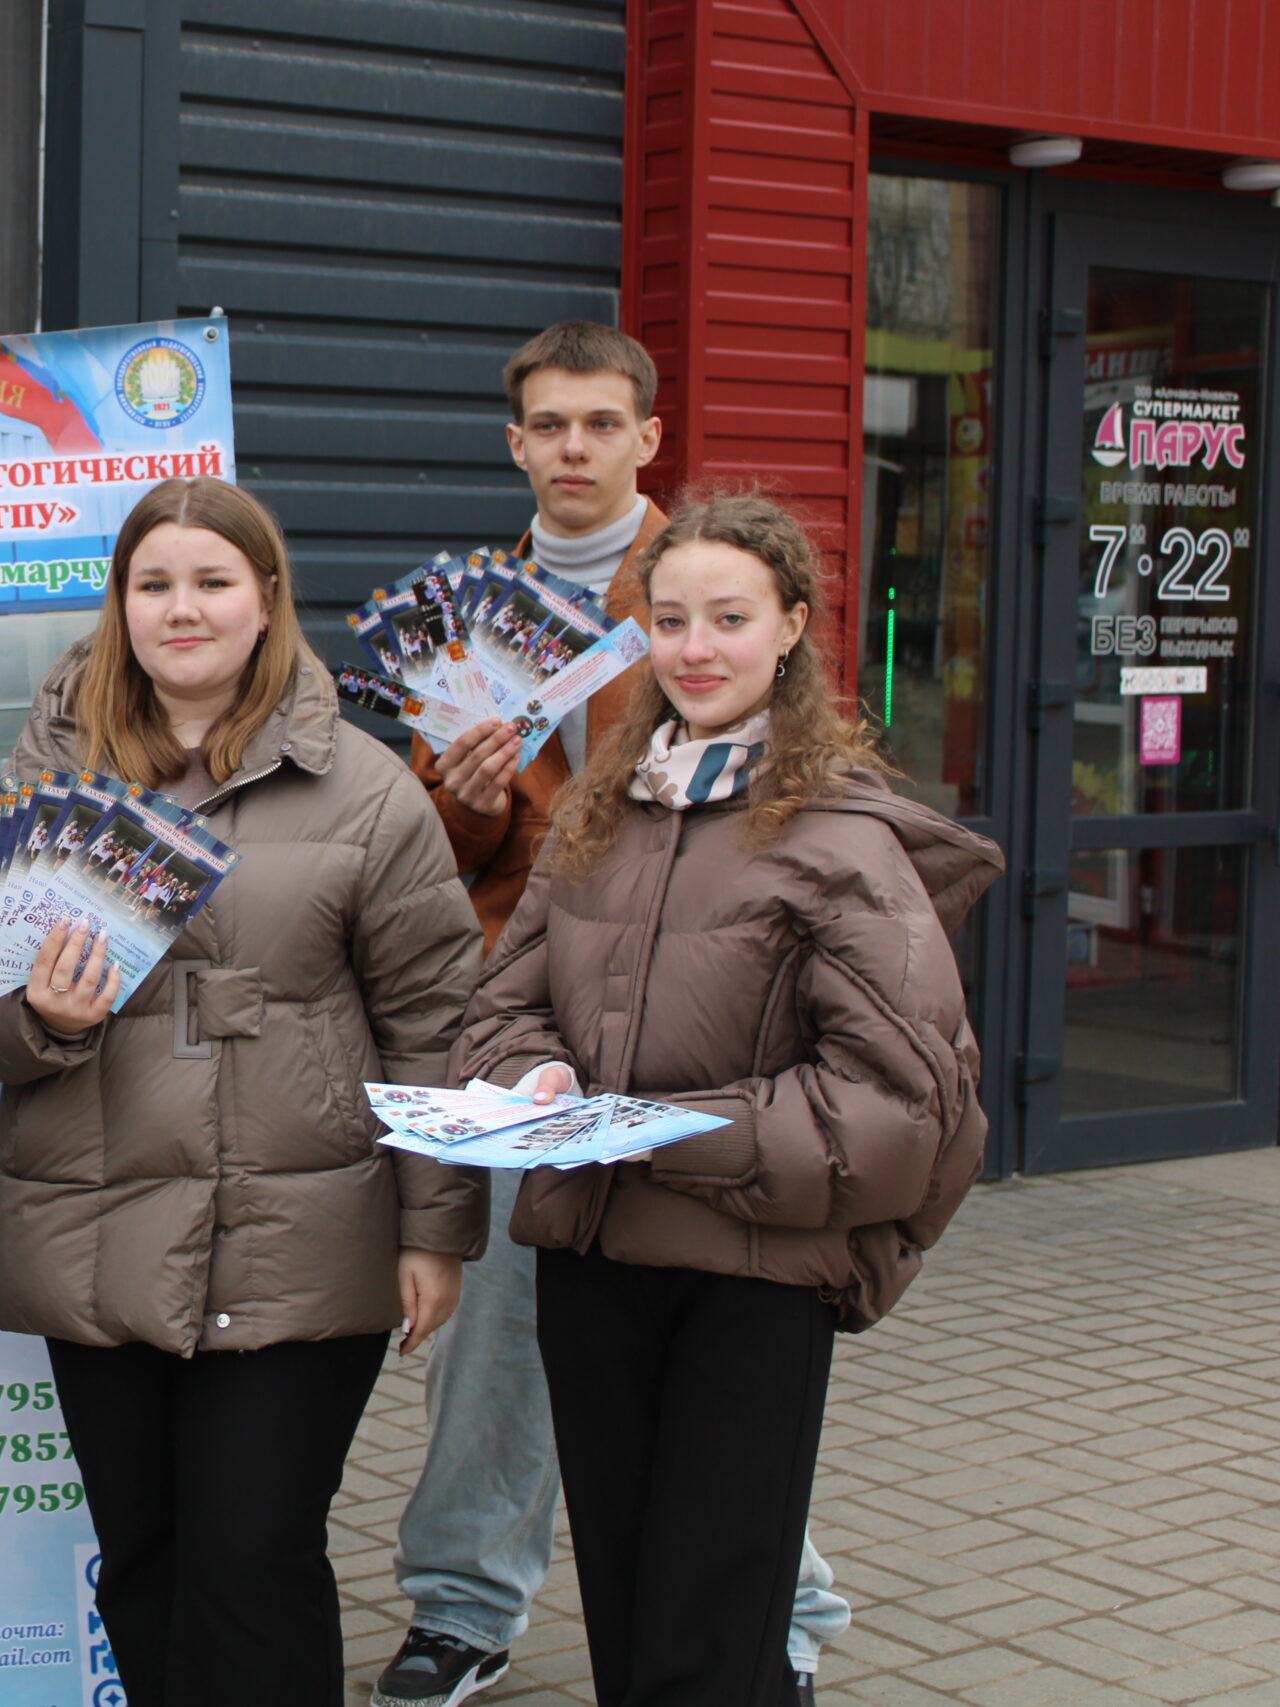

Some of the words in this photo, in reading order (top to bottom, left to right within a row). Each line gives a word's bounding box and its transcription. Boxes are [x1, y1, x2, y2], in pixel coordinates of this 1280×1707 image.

[1133, 400, 1241, 421] СУПЕРМАРКЕТ
[1129, 418, 1246, 472] ПАРУС
[1100, 481, 1161, 506] ВРЕМЯ
[1164, 483, 1237, 507] РАБОТЫ
[1089, 525, 1127, 599] 7
[1157, 527, 1232, 601] 22
[1091, 615, 1157, 657] БЕЗ
